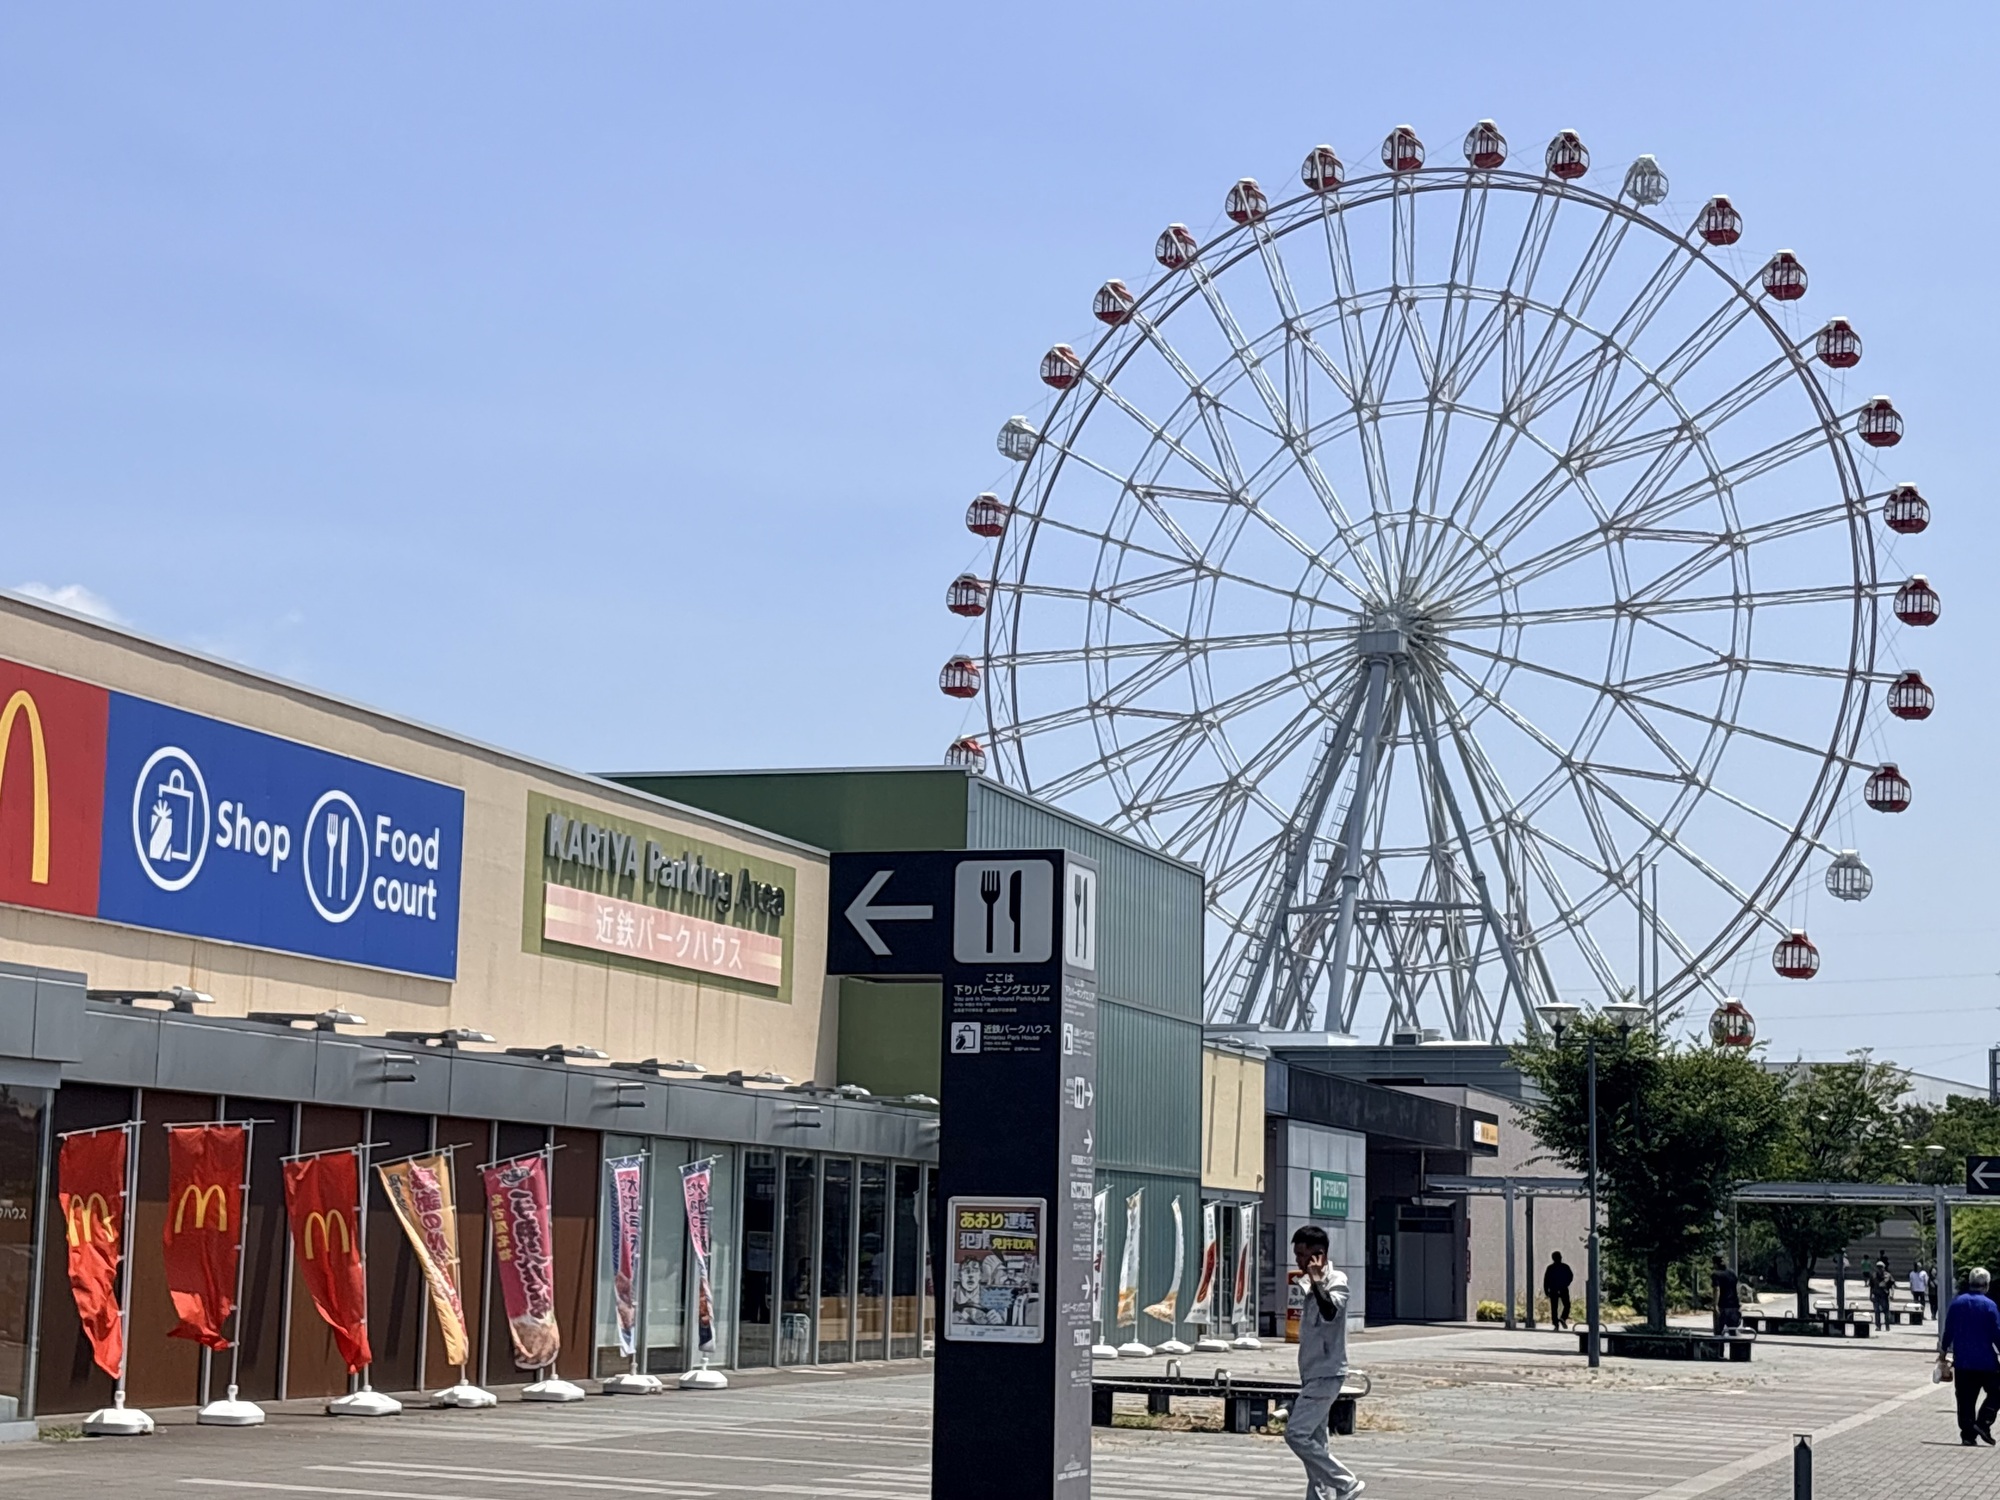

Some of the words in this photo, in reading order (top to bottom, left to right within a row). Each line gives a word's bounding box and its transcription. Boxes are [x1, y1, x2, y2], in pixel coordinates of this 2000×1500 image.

[216, 801, 290, 873] Shop
[375, 814, 440, 871] Food
[544, 813, 639, 880] KARIYA
[644, 841, 733, 913] Parking
[735, 868, 785, 917] Area
[373, 876, 437, 920] court
[596, 904, 743, 970] 近鉄パークハウス
[953, 984, 1051, 996] 下りパーキングエリア
[985, 973, 1015, 983] ここは
[983, 1024, 1053, 1034] 近鉄パークハウス
[960, 1211, 1036, 1230] あおり運転
